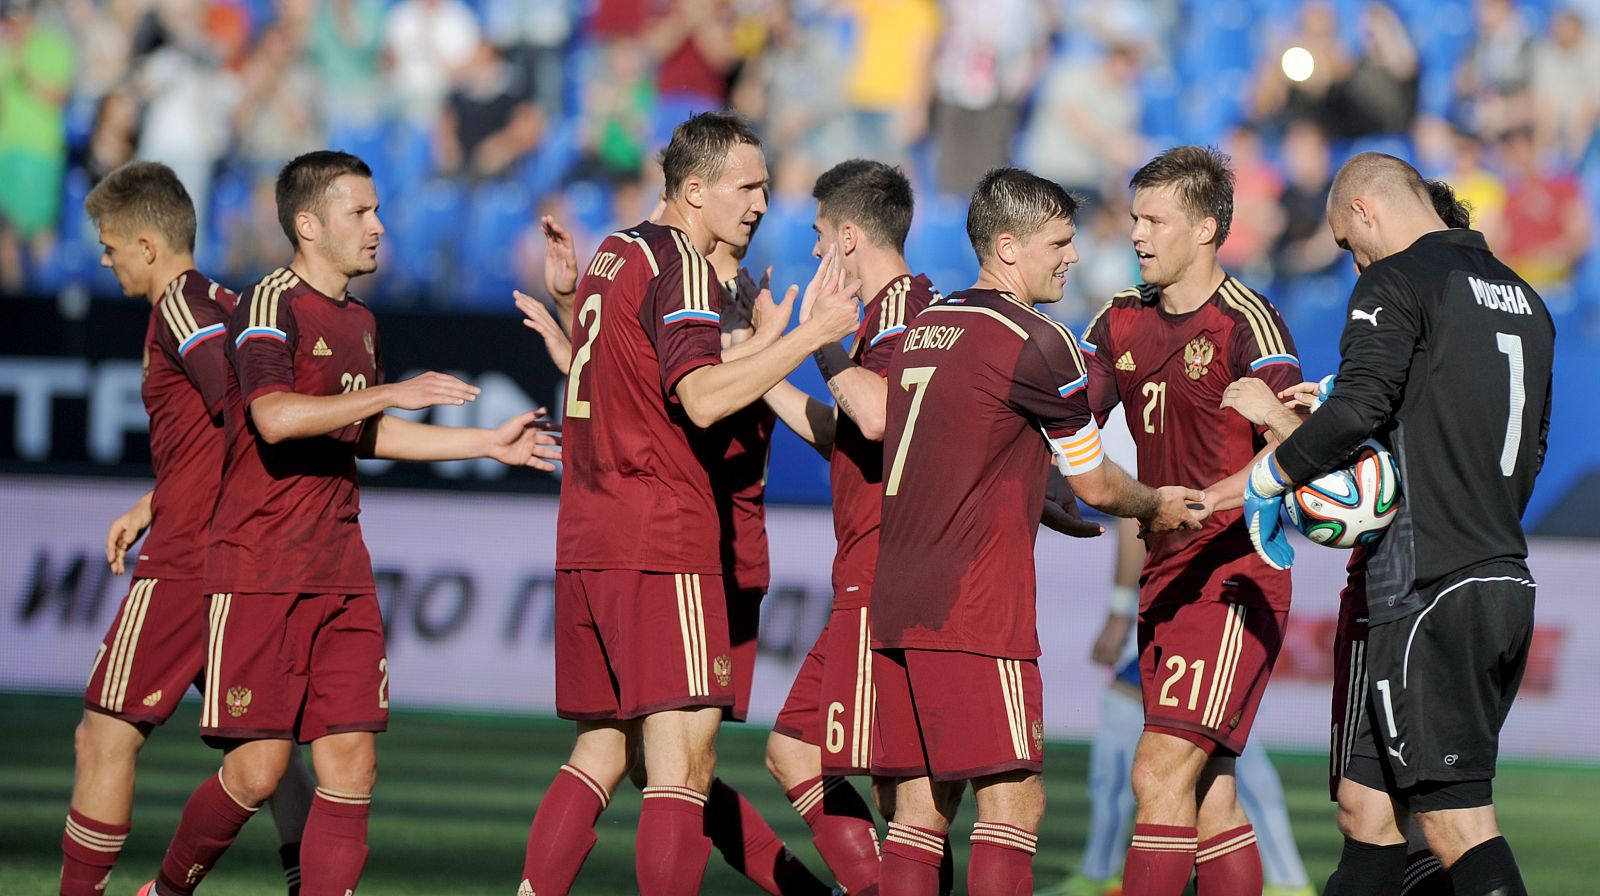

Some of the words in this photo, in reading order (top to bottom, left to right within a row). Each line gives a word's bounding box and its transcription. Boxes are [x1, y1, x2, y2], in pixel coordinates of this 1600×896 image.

[1468, 276, 1533, 315] MUCHA
[566, 293, 602, 418] 2
[903, 325, 965, 353] DENISOV
[885, 366, 937, 496] 7
[1142, 381, 1167, 434] 21
[1496, 331, 1526, 477] 1
[1159, 654, 1206, 711] 21
[1376, 679, 1398, 738] 1
[825, 701, 846, 754] 6
